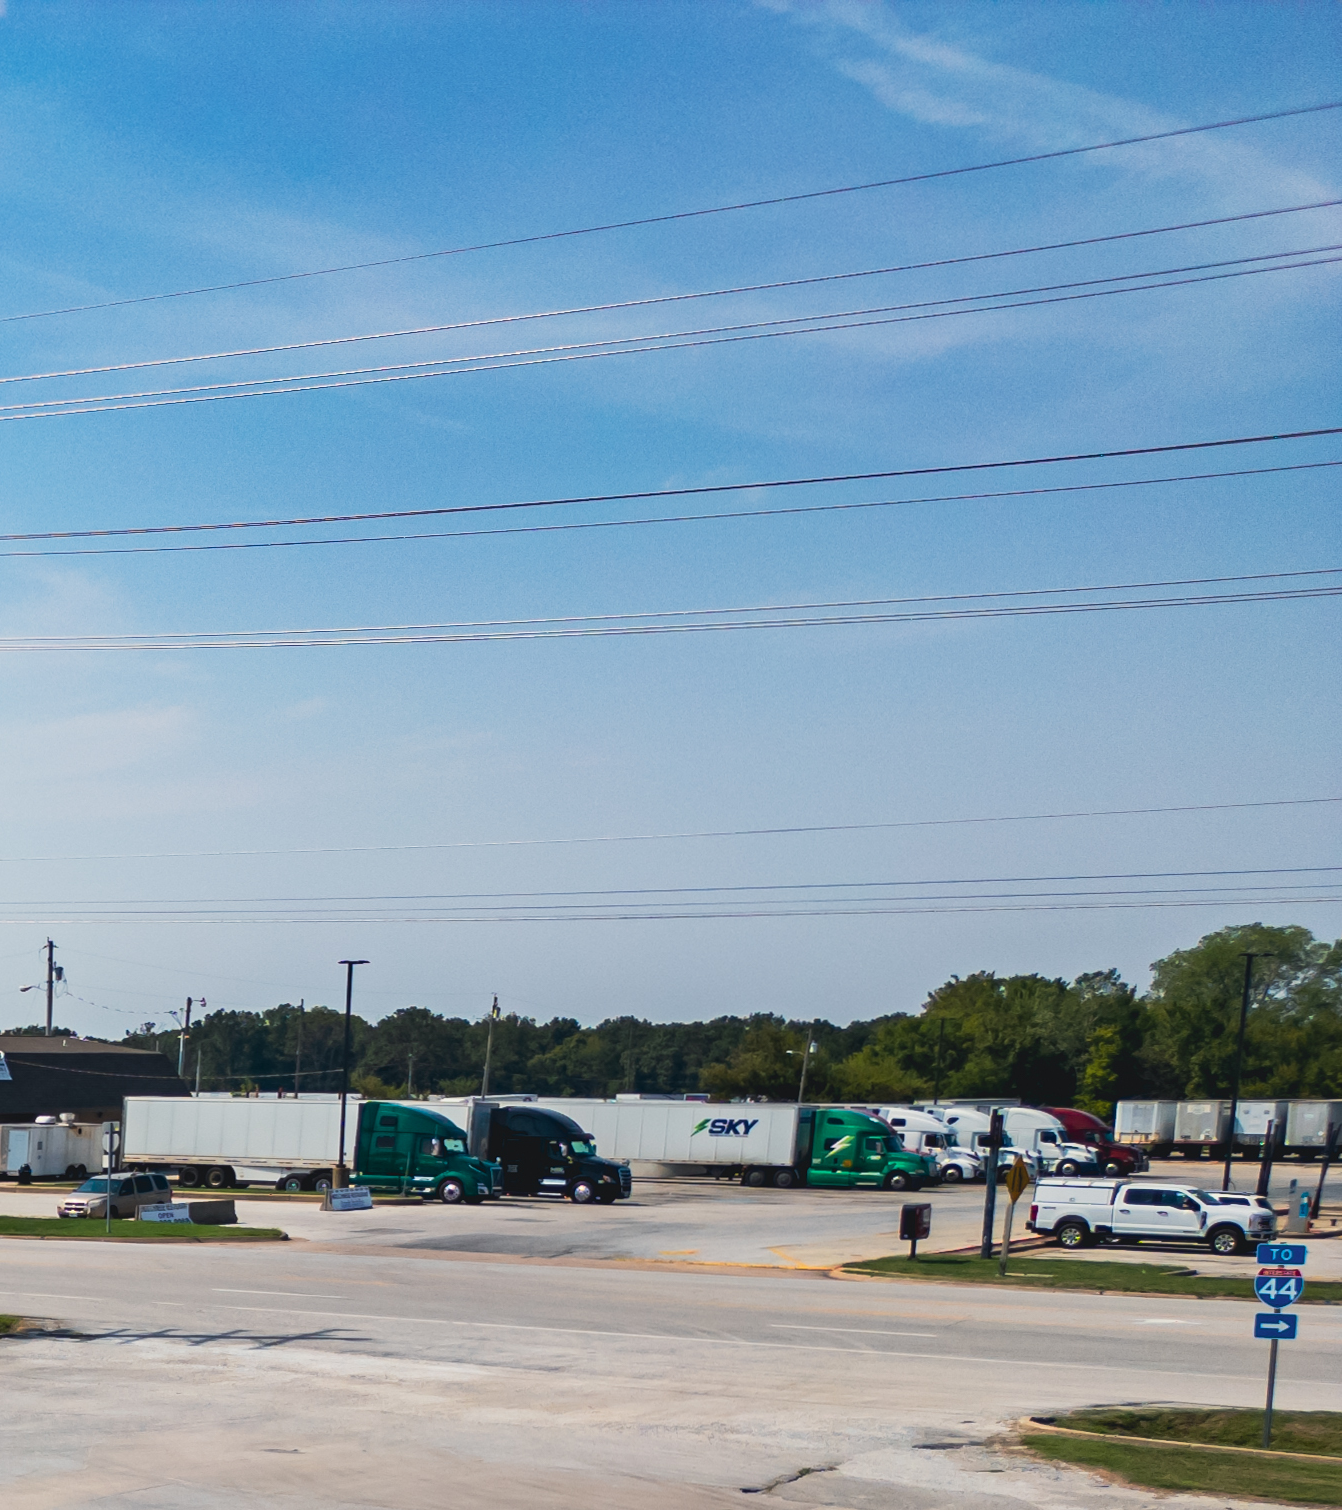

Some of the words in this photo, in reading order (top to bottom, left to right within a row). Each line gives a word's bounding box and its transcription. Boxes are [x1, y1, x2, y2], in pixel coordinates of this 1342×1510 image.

[709, 1119, 759, 1135] SKY
[1270, 1248, 1293, 1261] TO
[1258, 1278, 1298, 1300] 44
